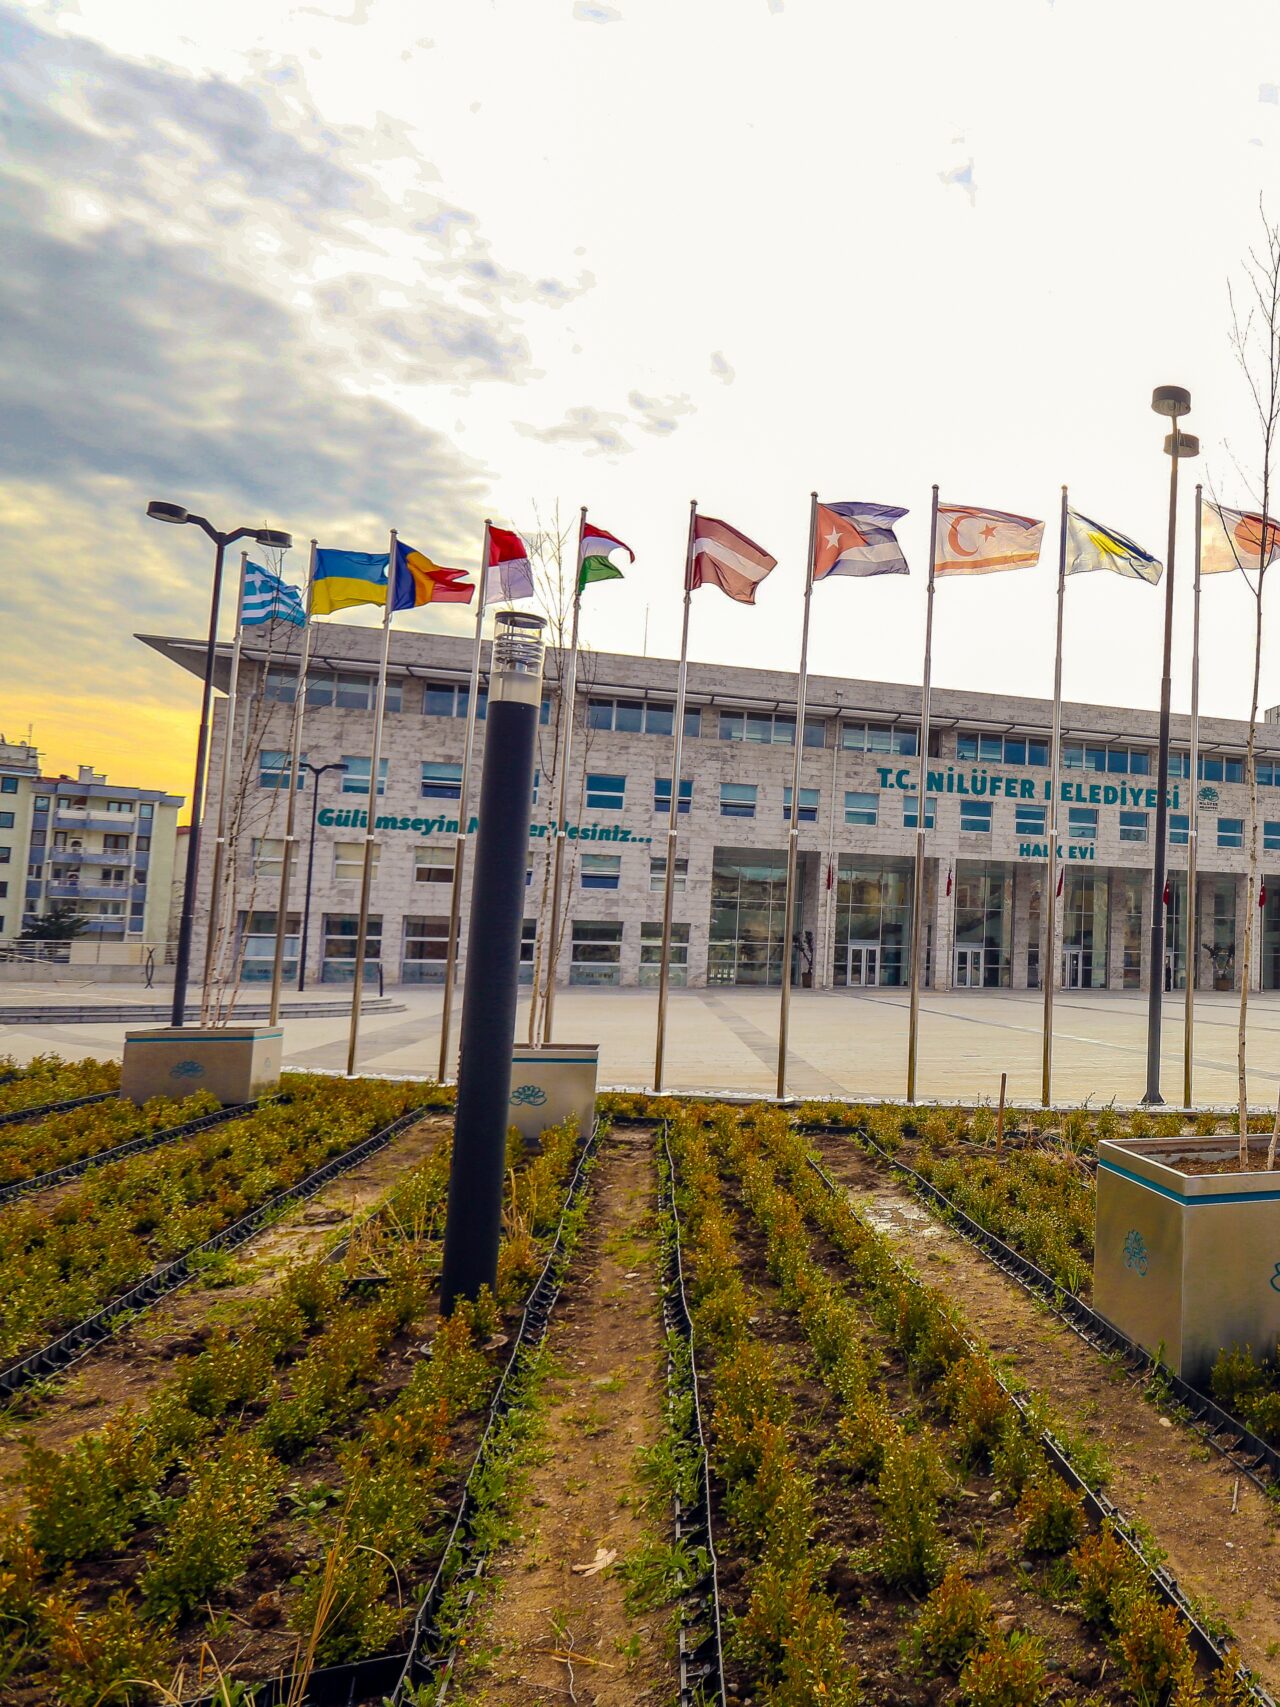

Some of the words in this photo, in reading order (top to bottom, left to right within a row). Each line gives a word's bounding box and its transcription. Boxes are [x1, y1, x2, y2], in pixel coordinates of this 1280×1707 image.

[876, 767, 917, 790] T.C.
[927, 766, 1035, 799] NİLÜFER
[1068, 842, 1095, 860] EVİ
